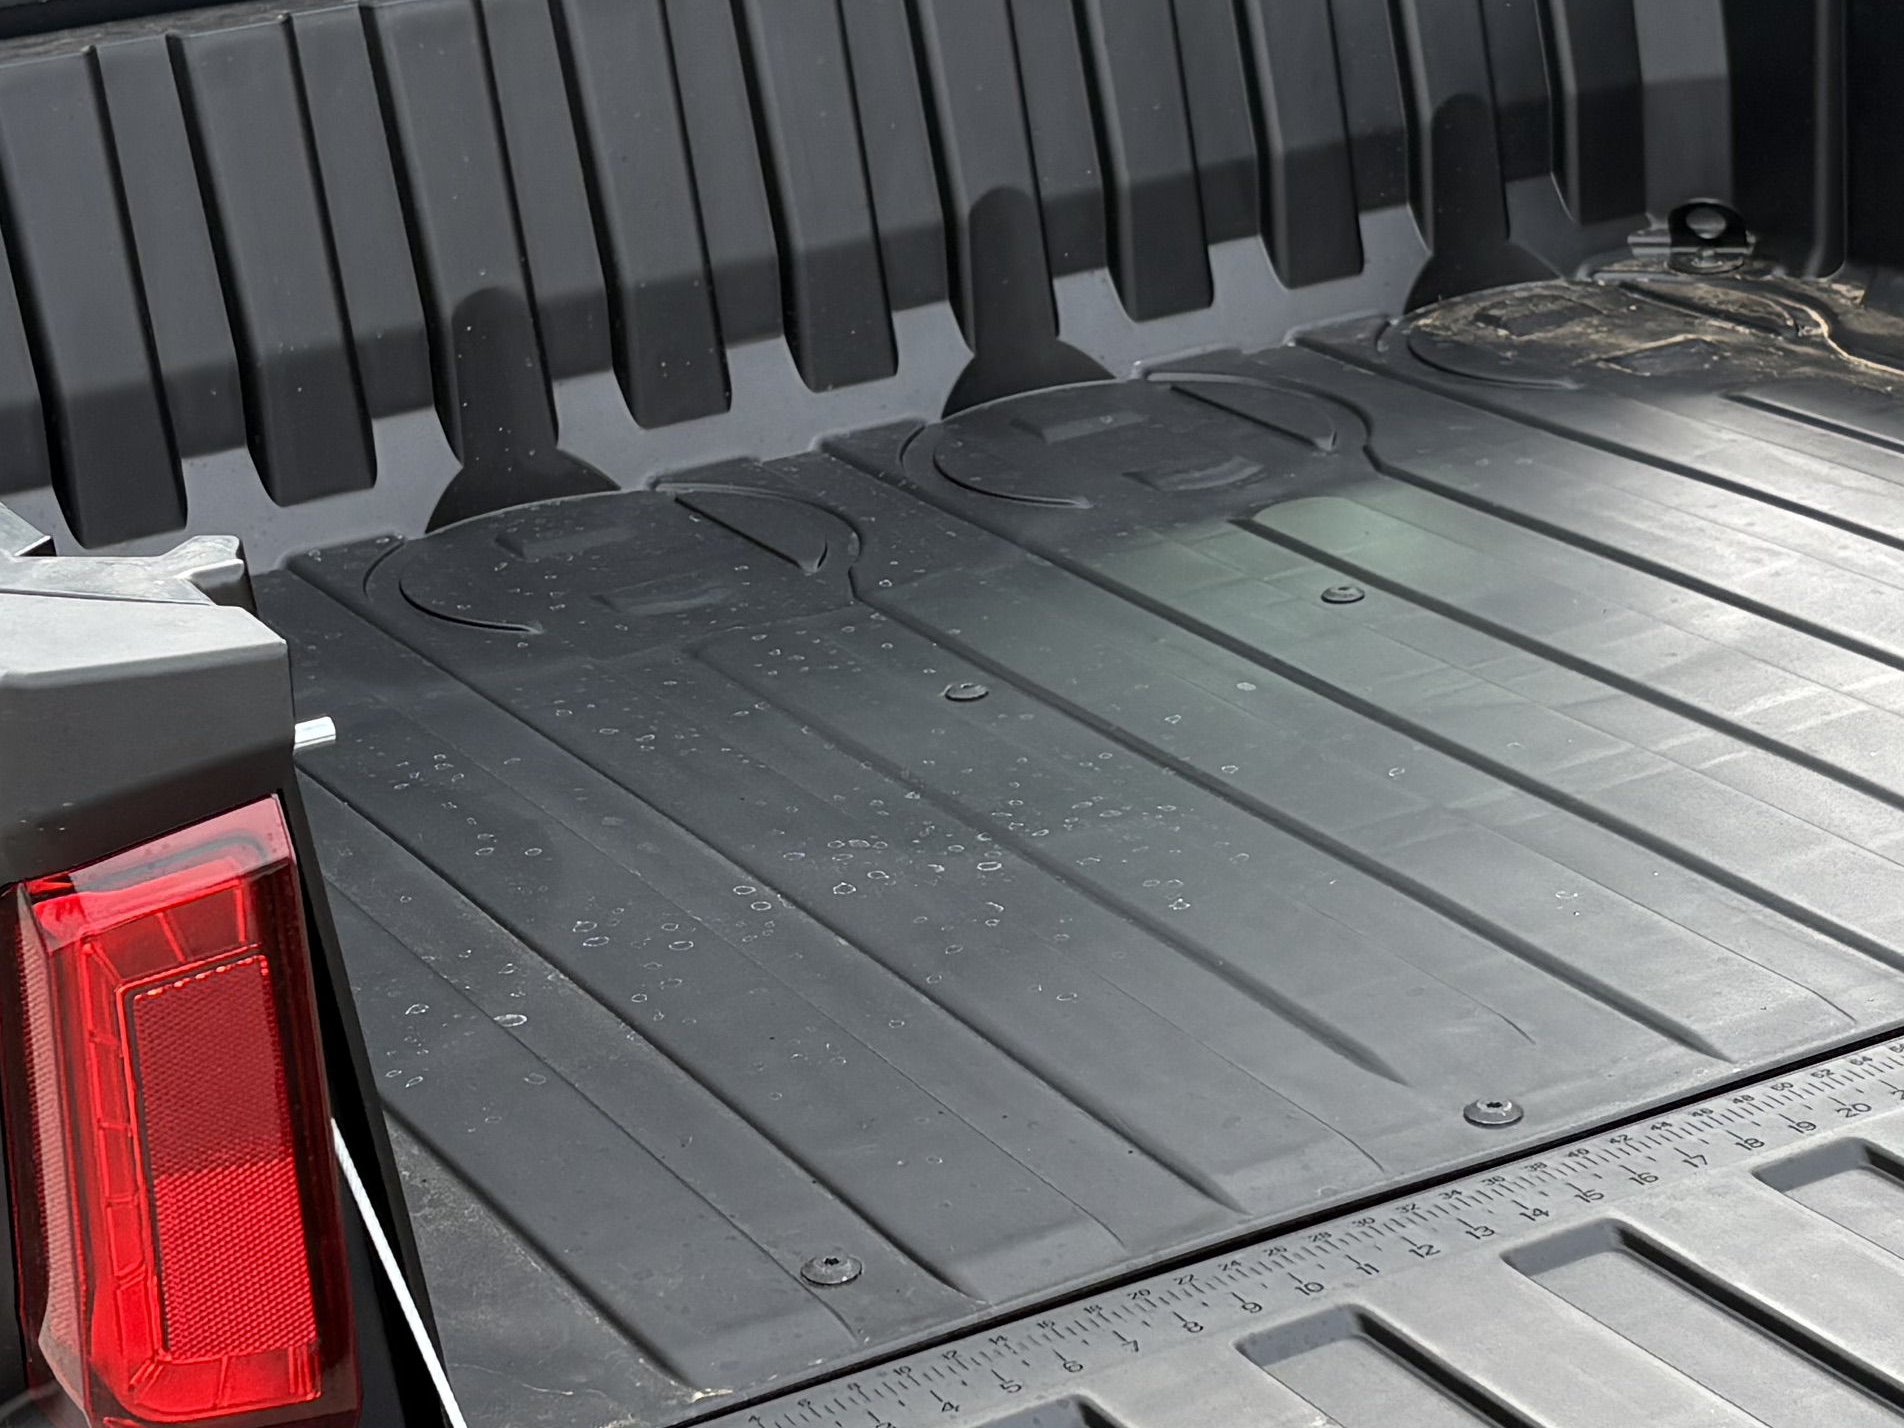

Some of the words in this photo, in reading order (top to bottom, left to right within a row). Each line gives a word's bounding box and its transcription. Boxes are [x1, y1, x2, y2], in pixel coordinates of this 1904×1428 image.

[942, 1401, 959, 1412] 4
[1001, 1380, 1021, 1392] 5
[1063, 1361, 1082, 1372] 6
[1183, 1321, 1203, 1332] 8
[1242, 1302, 1262, 1313] 9
[1295, 1283, 1323, 1295] 10
[1357, 1263, 1378, 1275] 11
[1409, 1245, 1440, 1258] 12
[1466, 1226, 1494, 1239] 13
[1520, 1208, 1548, 1221] 14
[1575, 1190, 1604, 1202] 15
[1629, 1173, 1658, 1184] 16
[1684, 1155, 1707, 1167] 17
[1736, 1138, 1764, 1150] 18
[1789, 1121, 1816, 1133] 19
[1837, 1103, 1871, 1117] 20
